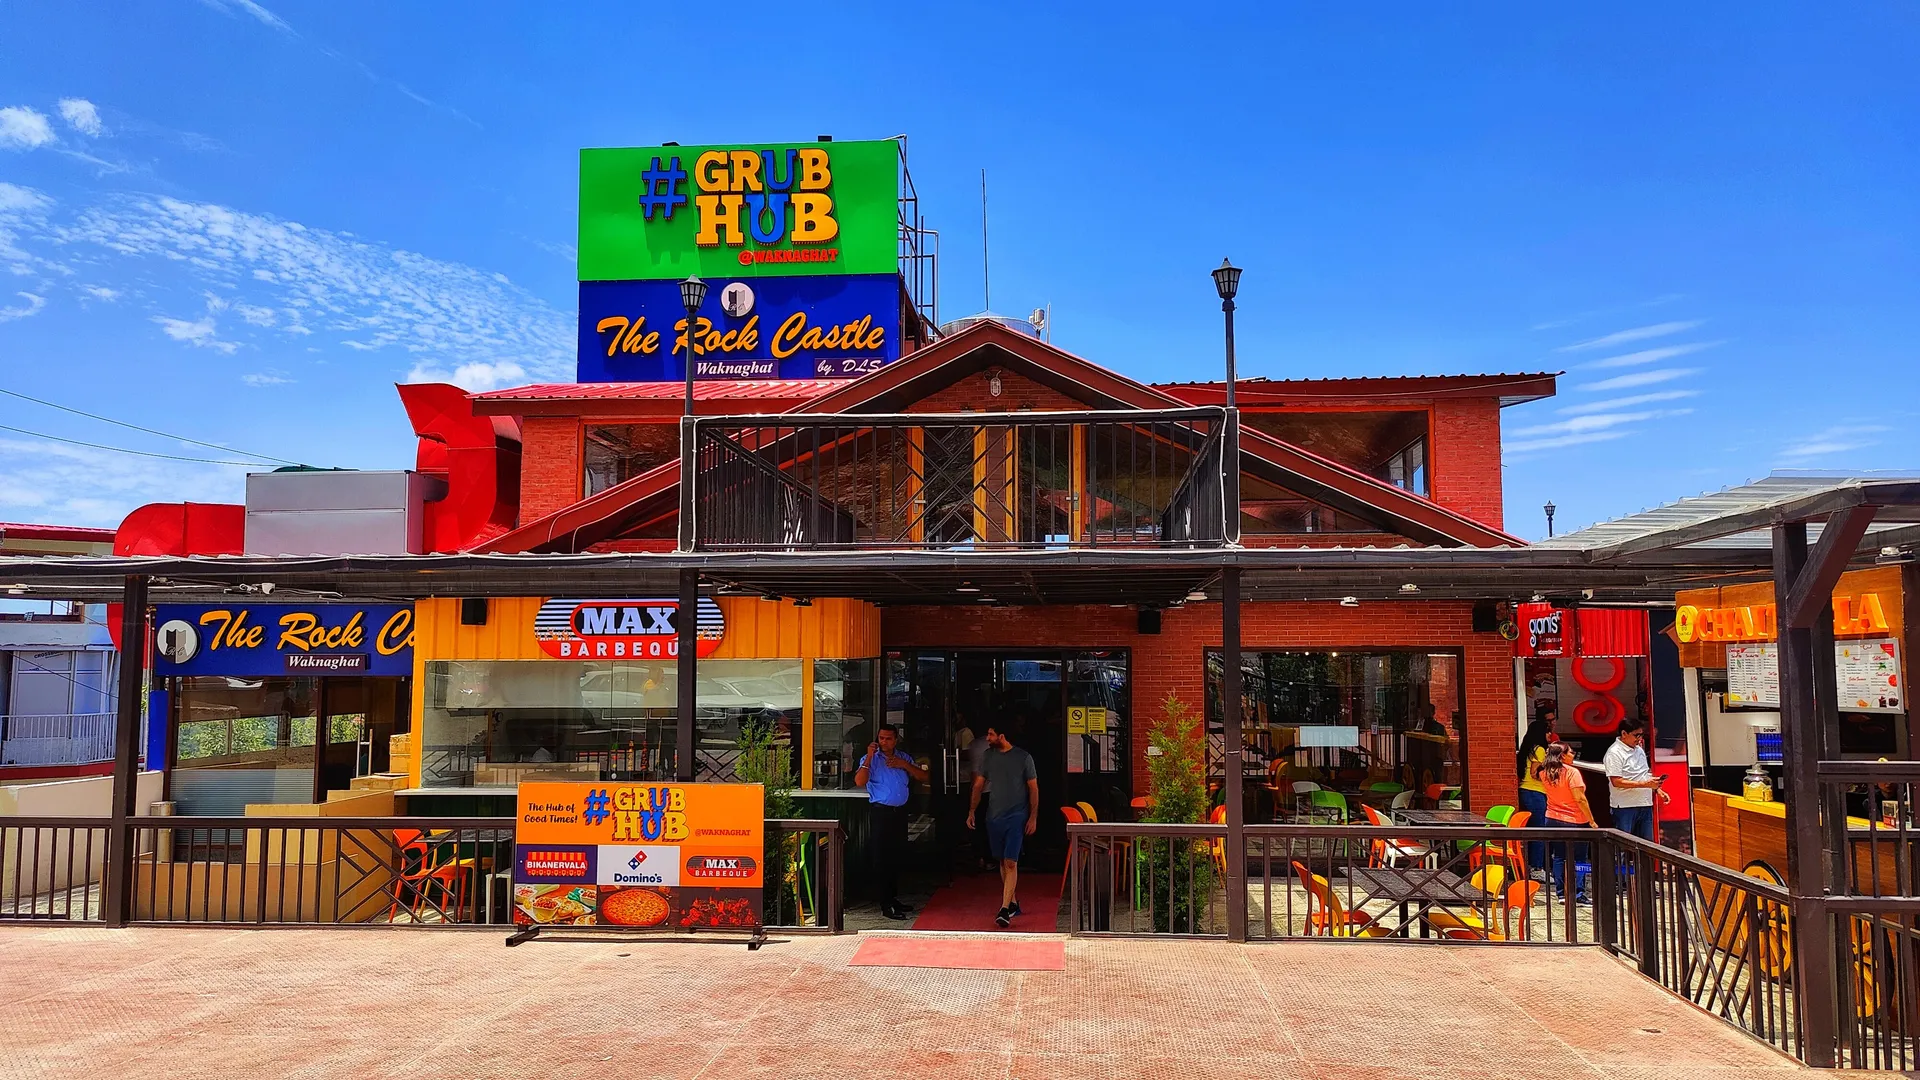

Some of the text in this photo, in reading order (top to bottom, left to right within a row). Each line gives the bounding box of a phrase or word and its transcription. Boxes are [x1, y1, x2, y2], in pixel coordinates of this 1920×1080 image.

[694, 148, 833, 193] GRUB
[694, 192, 840, 248] HUB
[738, 248, 839, 266] @WAKNAGHAT
[596, 311, 885, 359] The Rock Castle
[696, 361, 774, 377] Waknaghat
[842, 359, 882, 373] DLS
[581, 607, 676, 635] MAX
[199, 609, 264, 651] The
[276, 611, 366, 652] Rock
[560, 641, 679, 657] BARBEQU
[288, 655, 360, 670] Waknaghat
[528, 802, 576, 813] The Hub of
[612, 786, 687, 812] GRUB
[524, 814, 578, 824] Good Times!
[611, 811, 690, 842] HUB
[695, 828, 752, 837] @WAKNAGHAT
[526, 861, 586, 869] BIKANERVALA
[705, 859, 737, 869] MAX
[613, 872, 663, 884] Domino's
